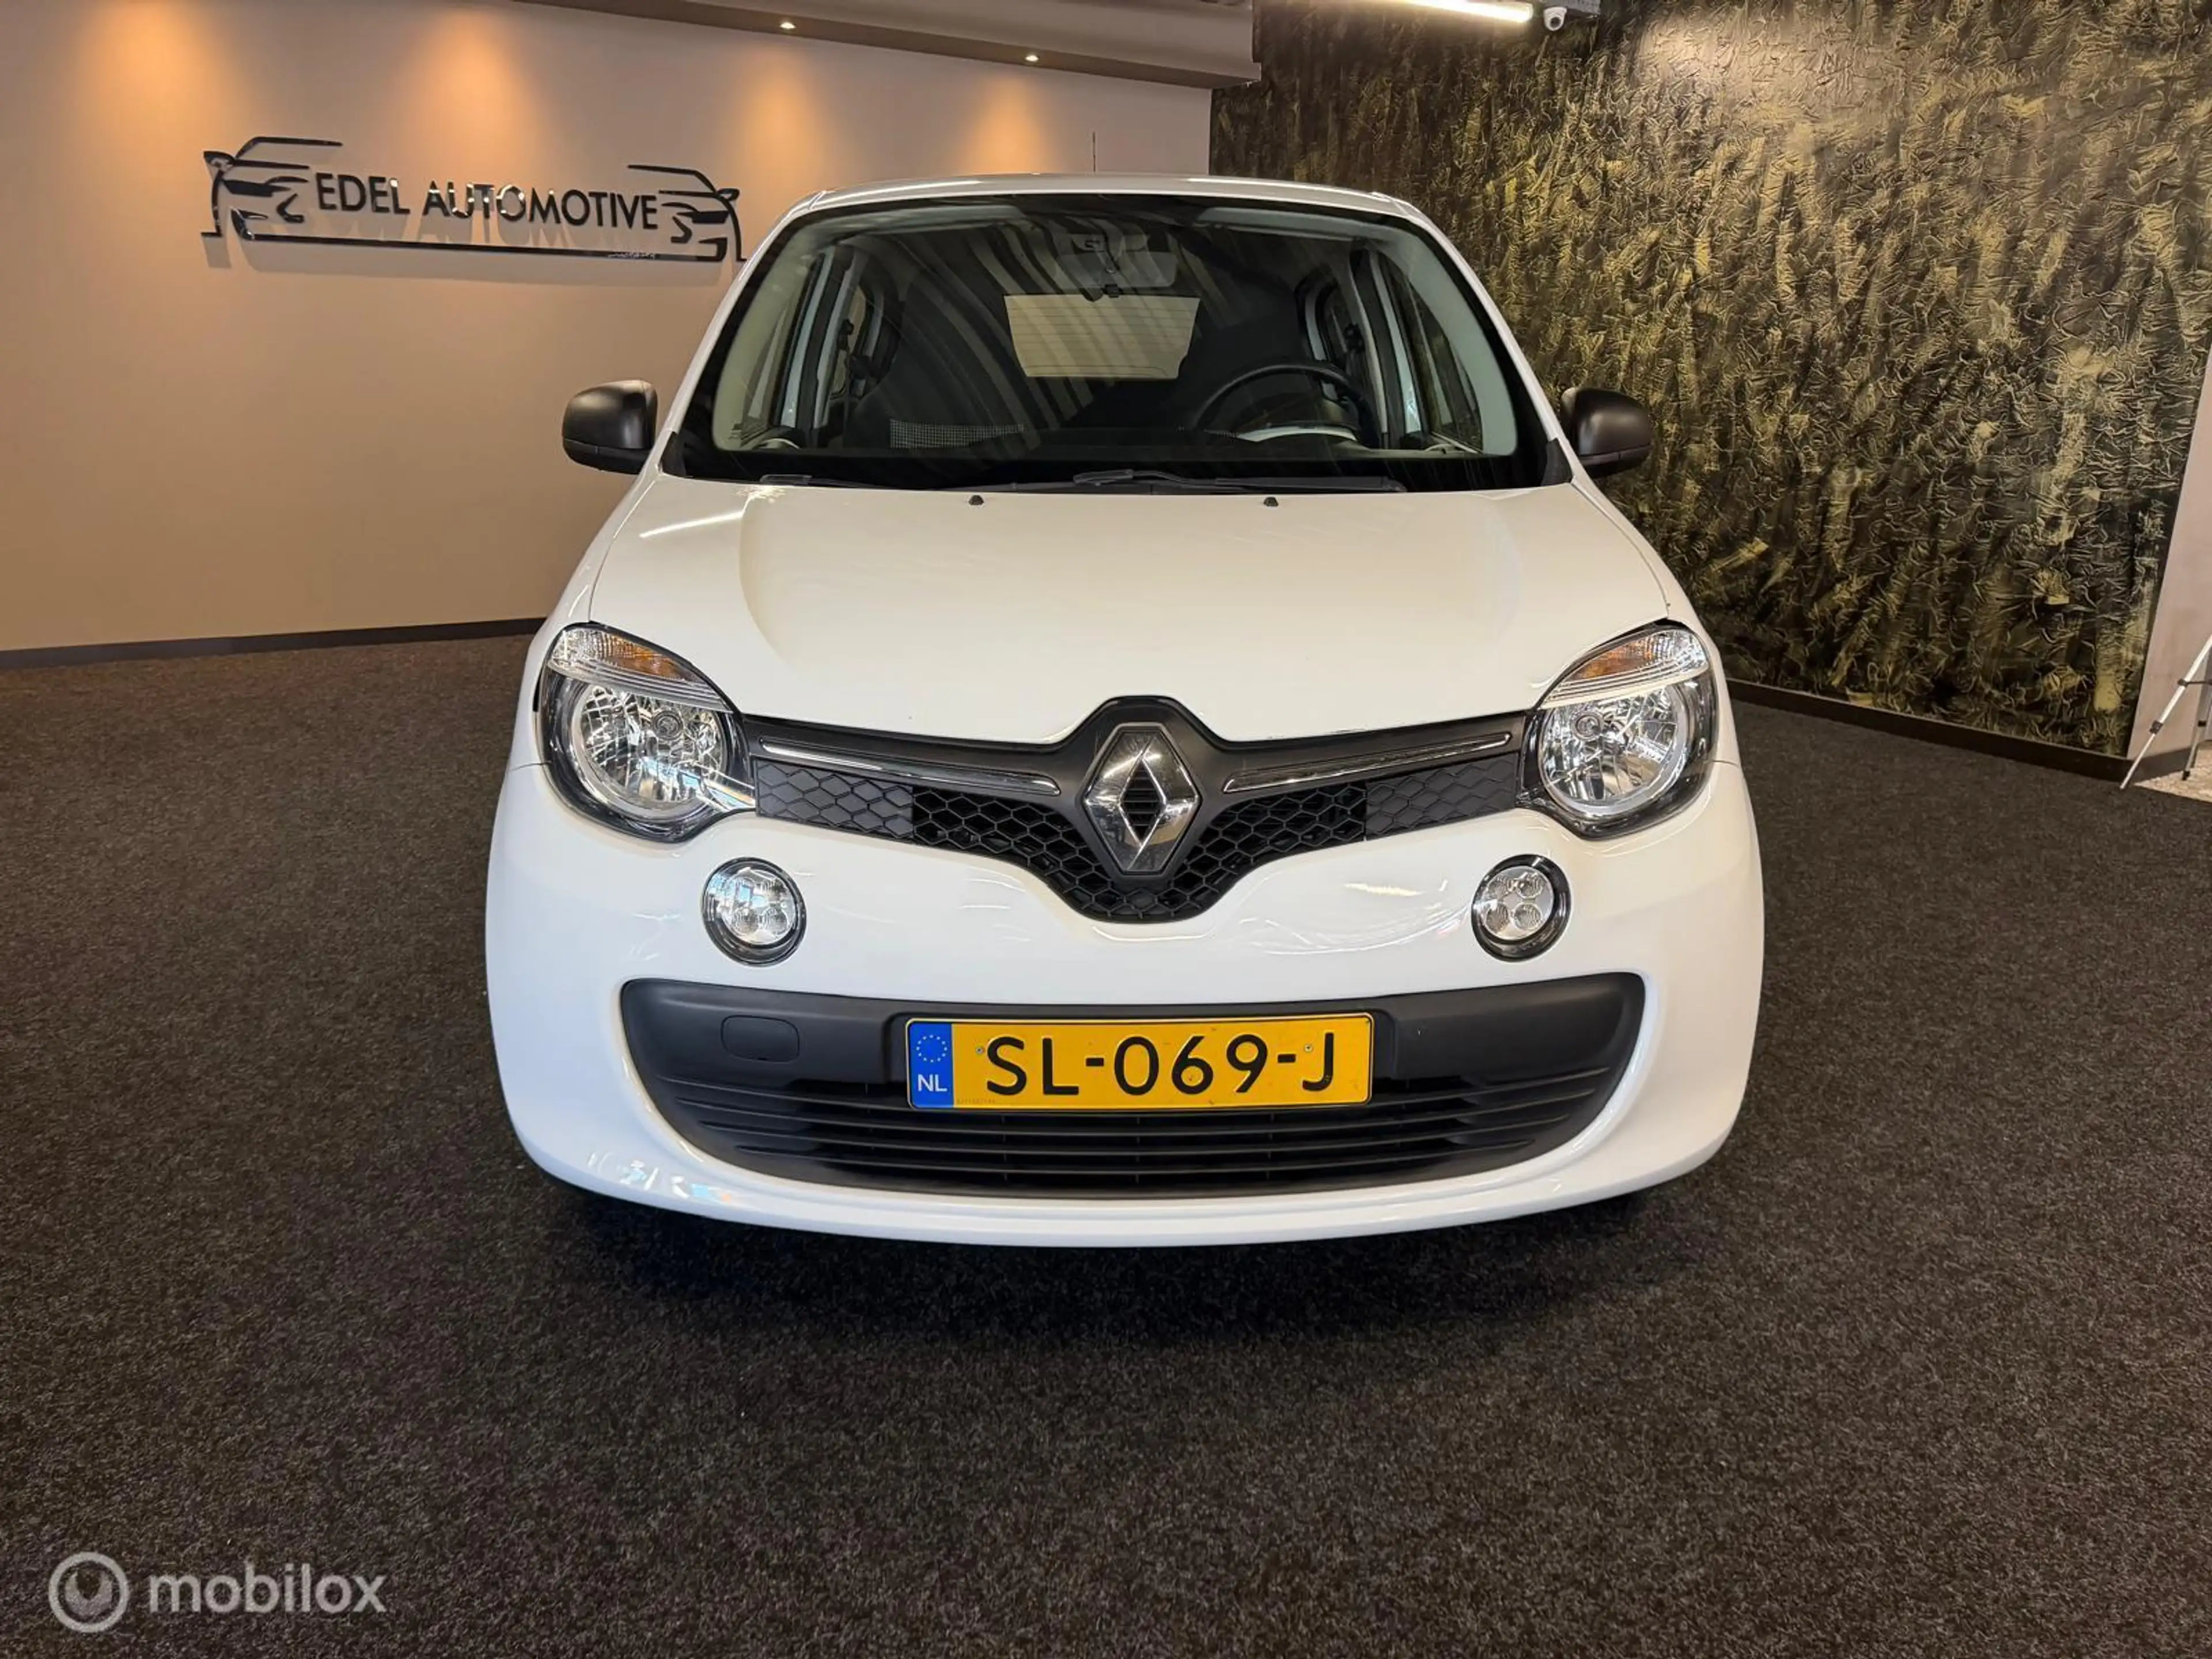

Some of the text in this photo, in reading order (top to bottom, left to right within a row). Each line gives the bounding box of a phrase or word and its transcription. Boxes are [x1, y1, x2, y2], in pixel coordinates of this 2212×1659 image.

[316, 172, 658, 230] EDEL AUTOMOTIVE
[917, 1074, 948, 1092] NL
[987, 1032, 1335, 1096] SL-069-J
